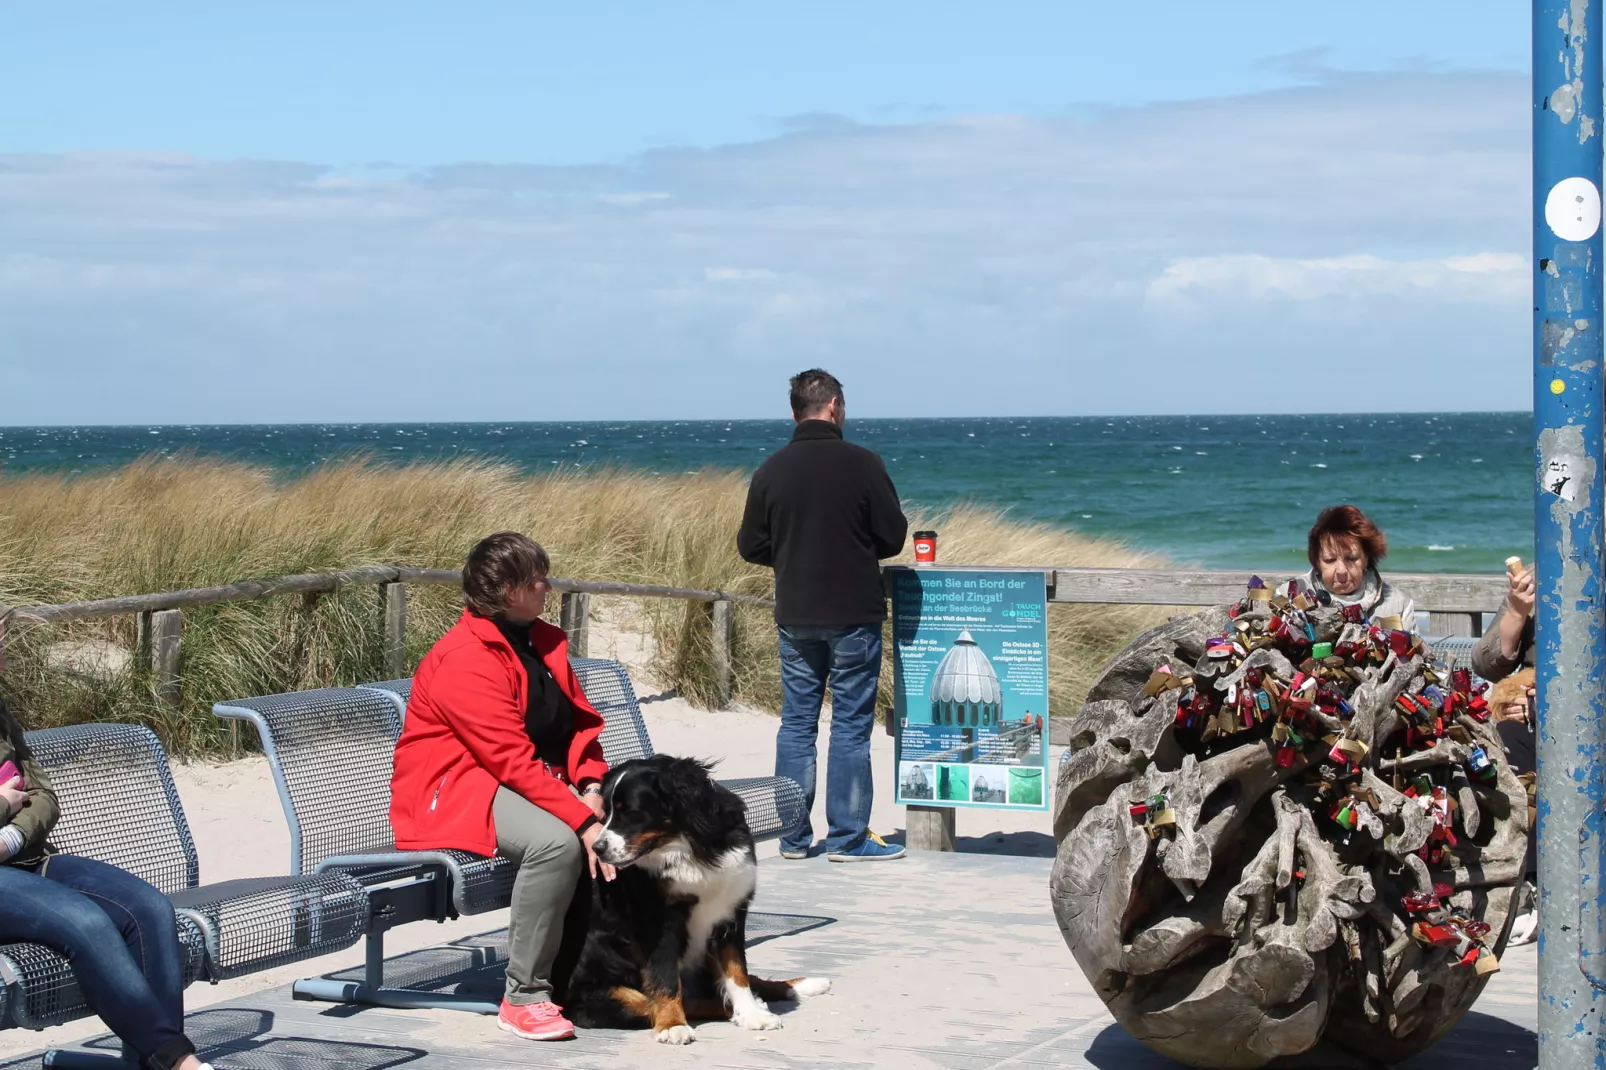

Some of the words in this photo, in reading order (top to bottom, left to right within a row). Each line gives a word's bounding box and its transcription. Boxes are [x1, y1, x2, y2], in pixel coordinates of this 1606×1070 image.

[945, 578, 961, 588] Sie
[964, 580, 977, 588] an
[979, 579, 1005, 589] Bord
[1007, 579, 1026, 589] der
[966, 592, 1003, 604] Zingst!
[934, 604, 948, 612] der
[949, 604, 992, 613] Seebrücke
